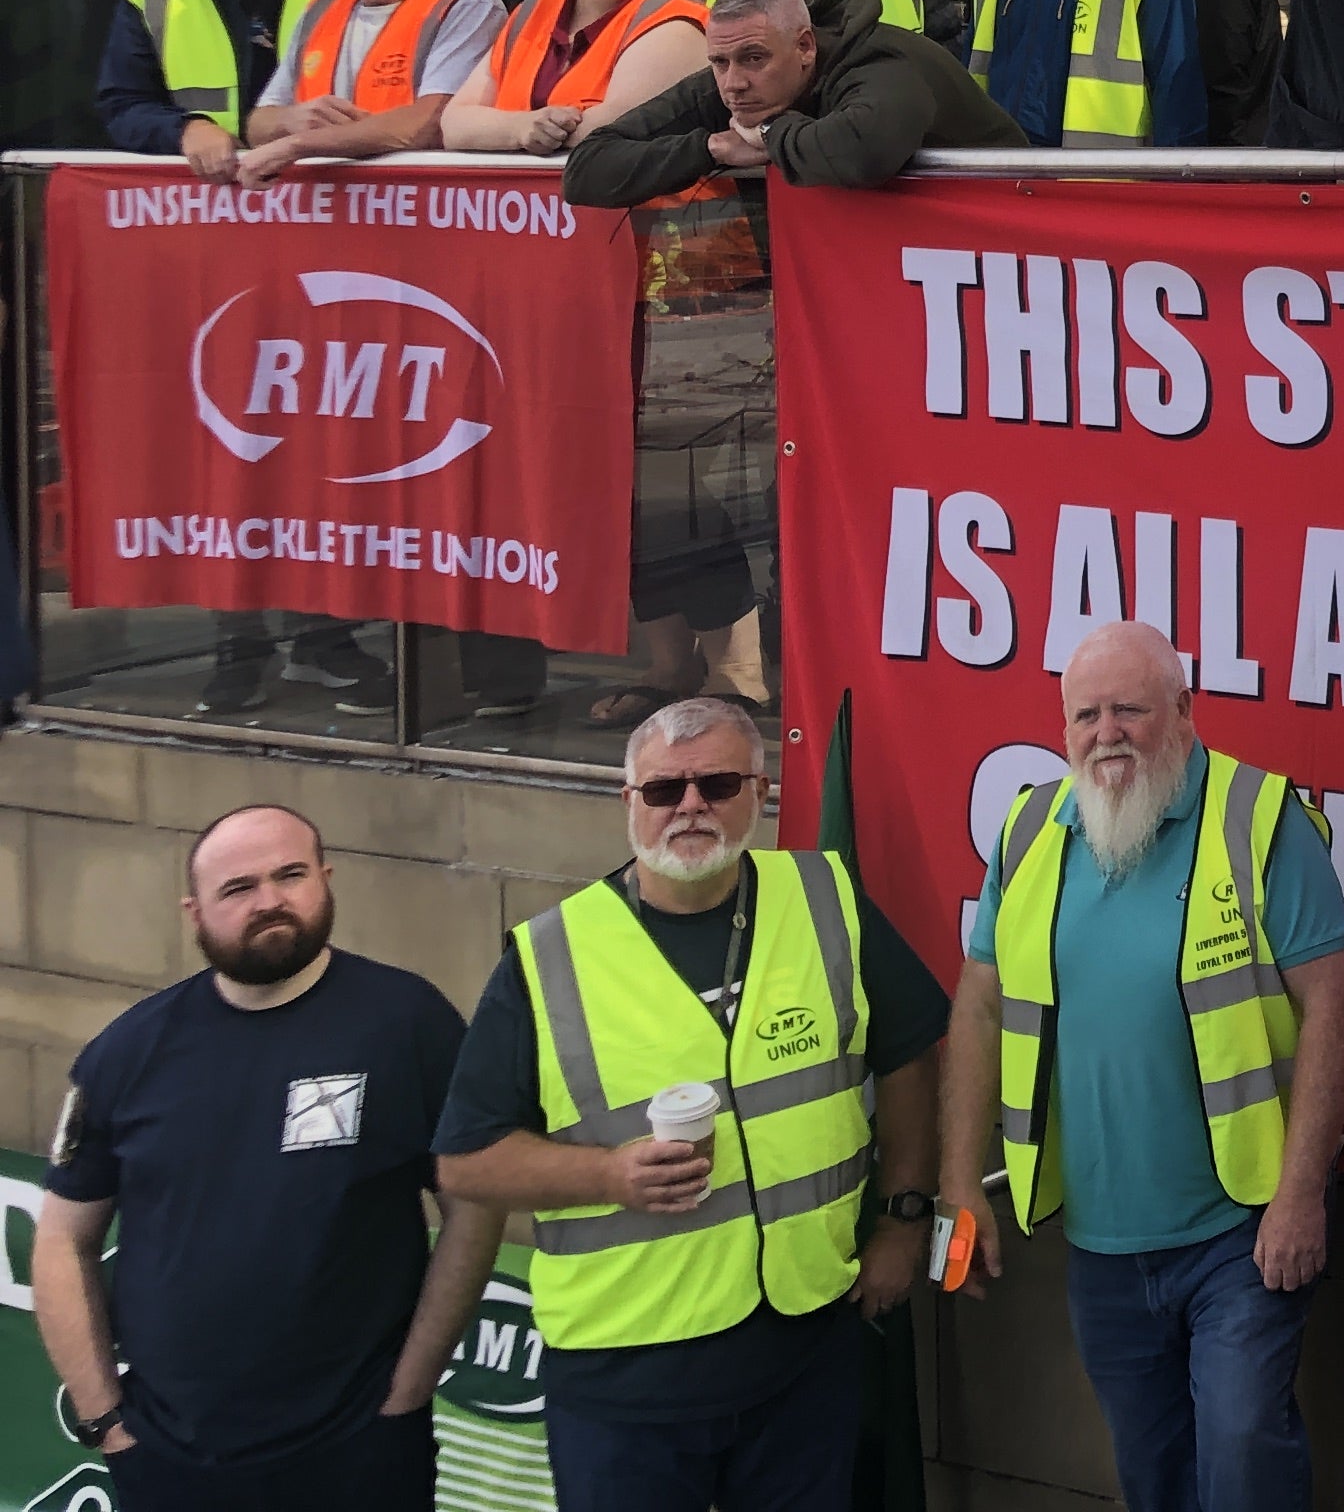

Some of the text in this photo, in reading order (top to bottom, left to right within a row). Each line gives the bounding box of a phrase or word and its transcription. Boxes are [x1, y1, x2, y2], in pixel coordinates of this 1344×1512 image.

[107, 183, 577, 240] UNSHACKLE THE UNIONS
[901, 246, 1207, 440] THIS
[243, 339, 446, 422] RMT
[432, 530, 558, 595] UNIONS
[880, 486, 1015, 668] IS
[1043, 502, 1261, 699] ALL
[1196, 929, 1247, 952] LIVERPOOL 5
[1196, 958, 1221, 971] LOYAL
[1222, 953, 1234, 964] TO
[767, 1034, 820, 1061] UNION
[770, 1013, 805, 1034] RMT
[450, 1319, 543, 1381] MT
